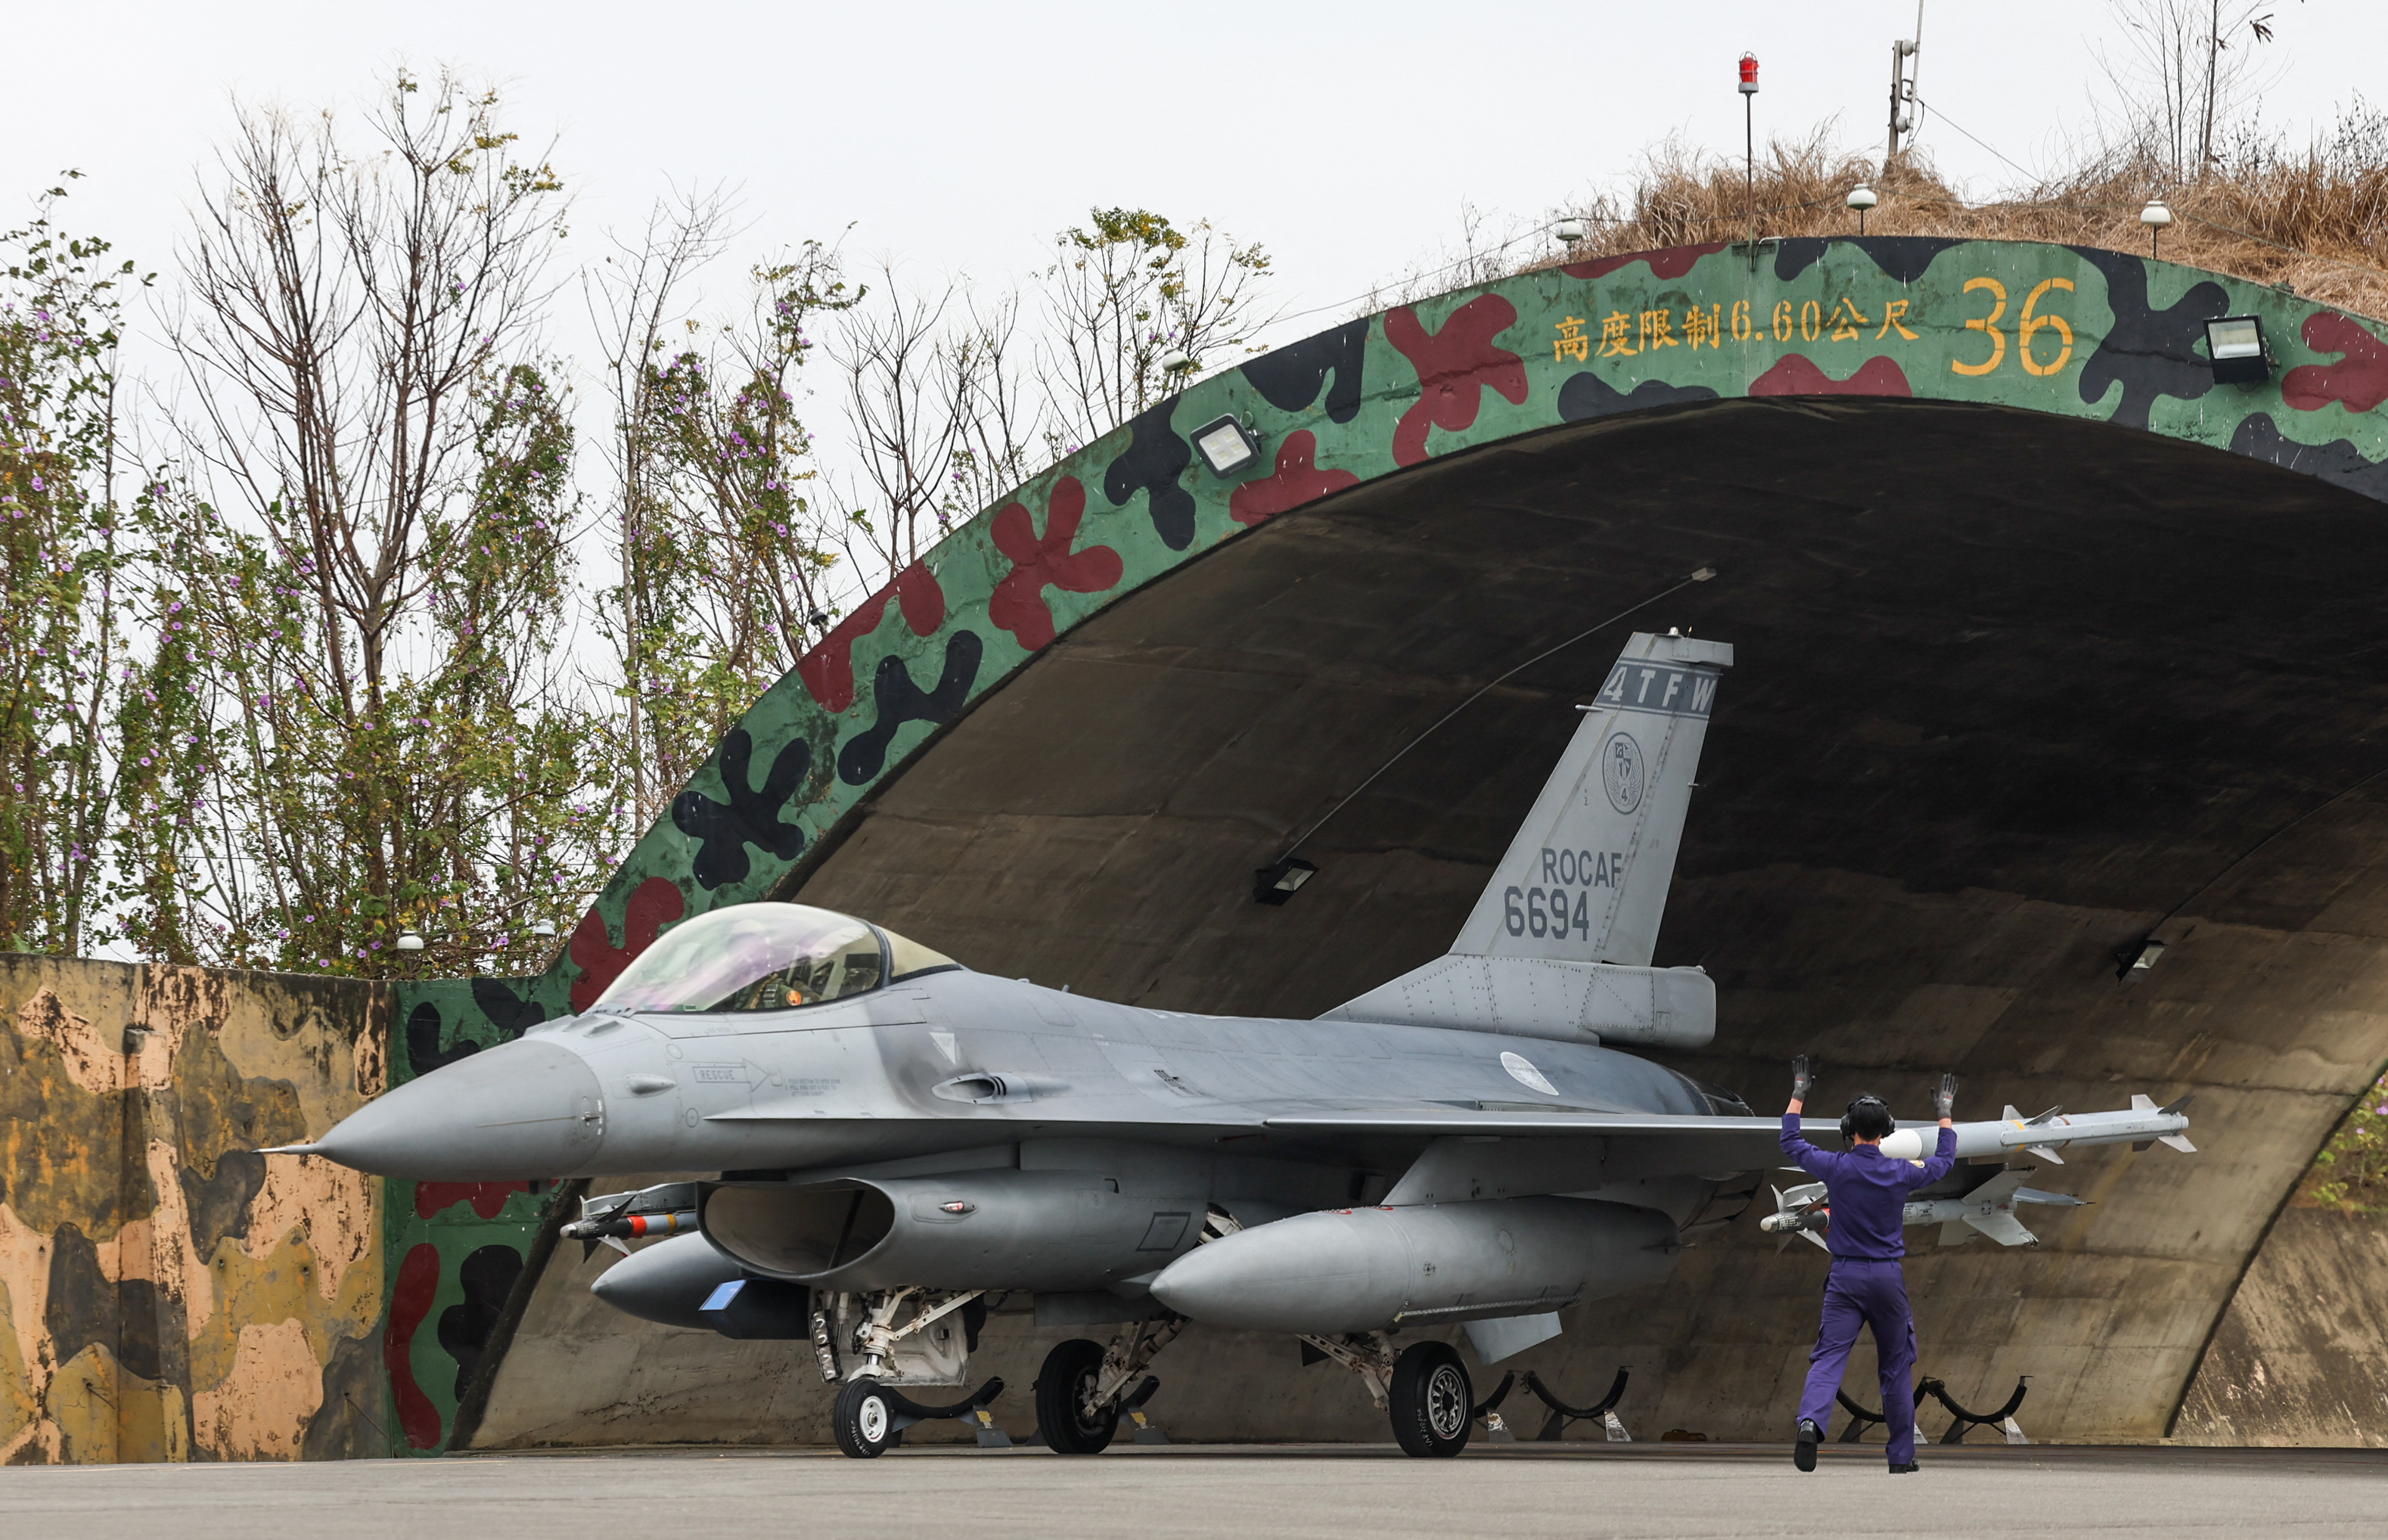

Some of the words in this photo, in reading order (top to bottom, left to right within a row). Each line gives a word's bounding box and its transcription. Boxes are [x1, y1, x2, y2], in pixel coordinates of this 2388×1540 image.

[1952, 277, 2074, 376] 36
[1621, 787, 1628, 802] 4
[1542, 848, 1622, 888] ROCAF
[1504, 886, 1589, 942] 6694
[700, 1070, 735, 1080] RESCUE
